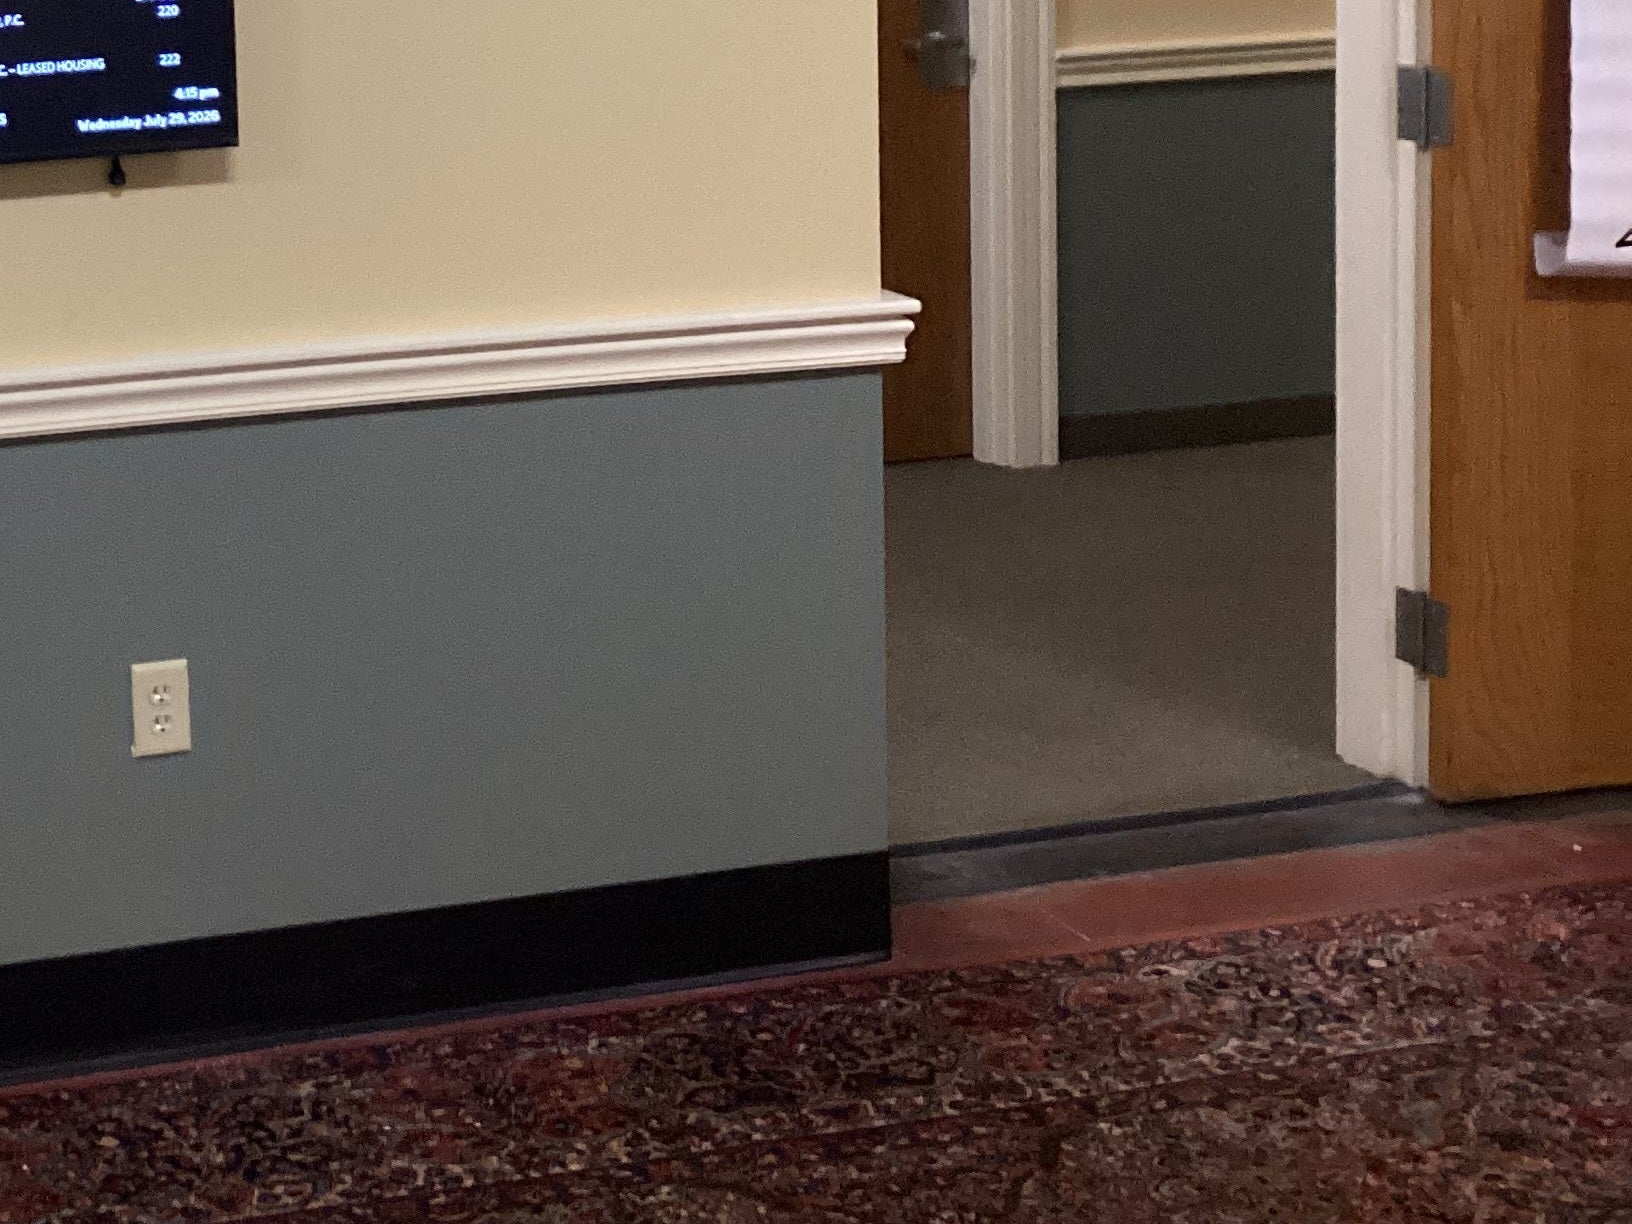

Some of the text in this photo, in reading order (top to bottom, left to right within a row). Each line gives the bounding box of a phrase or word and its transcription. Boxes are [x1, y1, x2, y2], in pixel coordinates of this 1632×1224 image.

[157, 4, 180, 17] 220
[4, 14, 24, 26] P.C.
[16, 61, 55, 75] LEASED
[56, 57, 106, 71] HOUSING
[159, 53, 181, 66] 222
[143, 113, 168, 129] July
